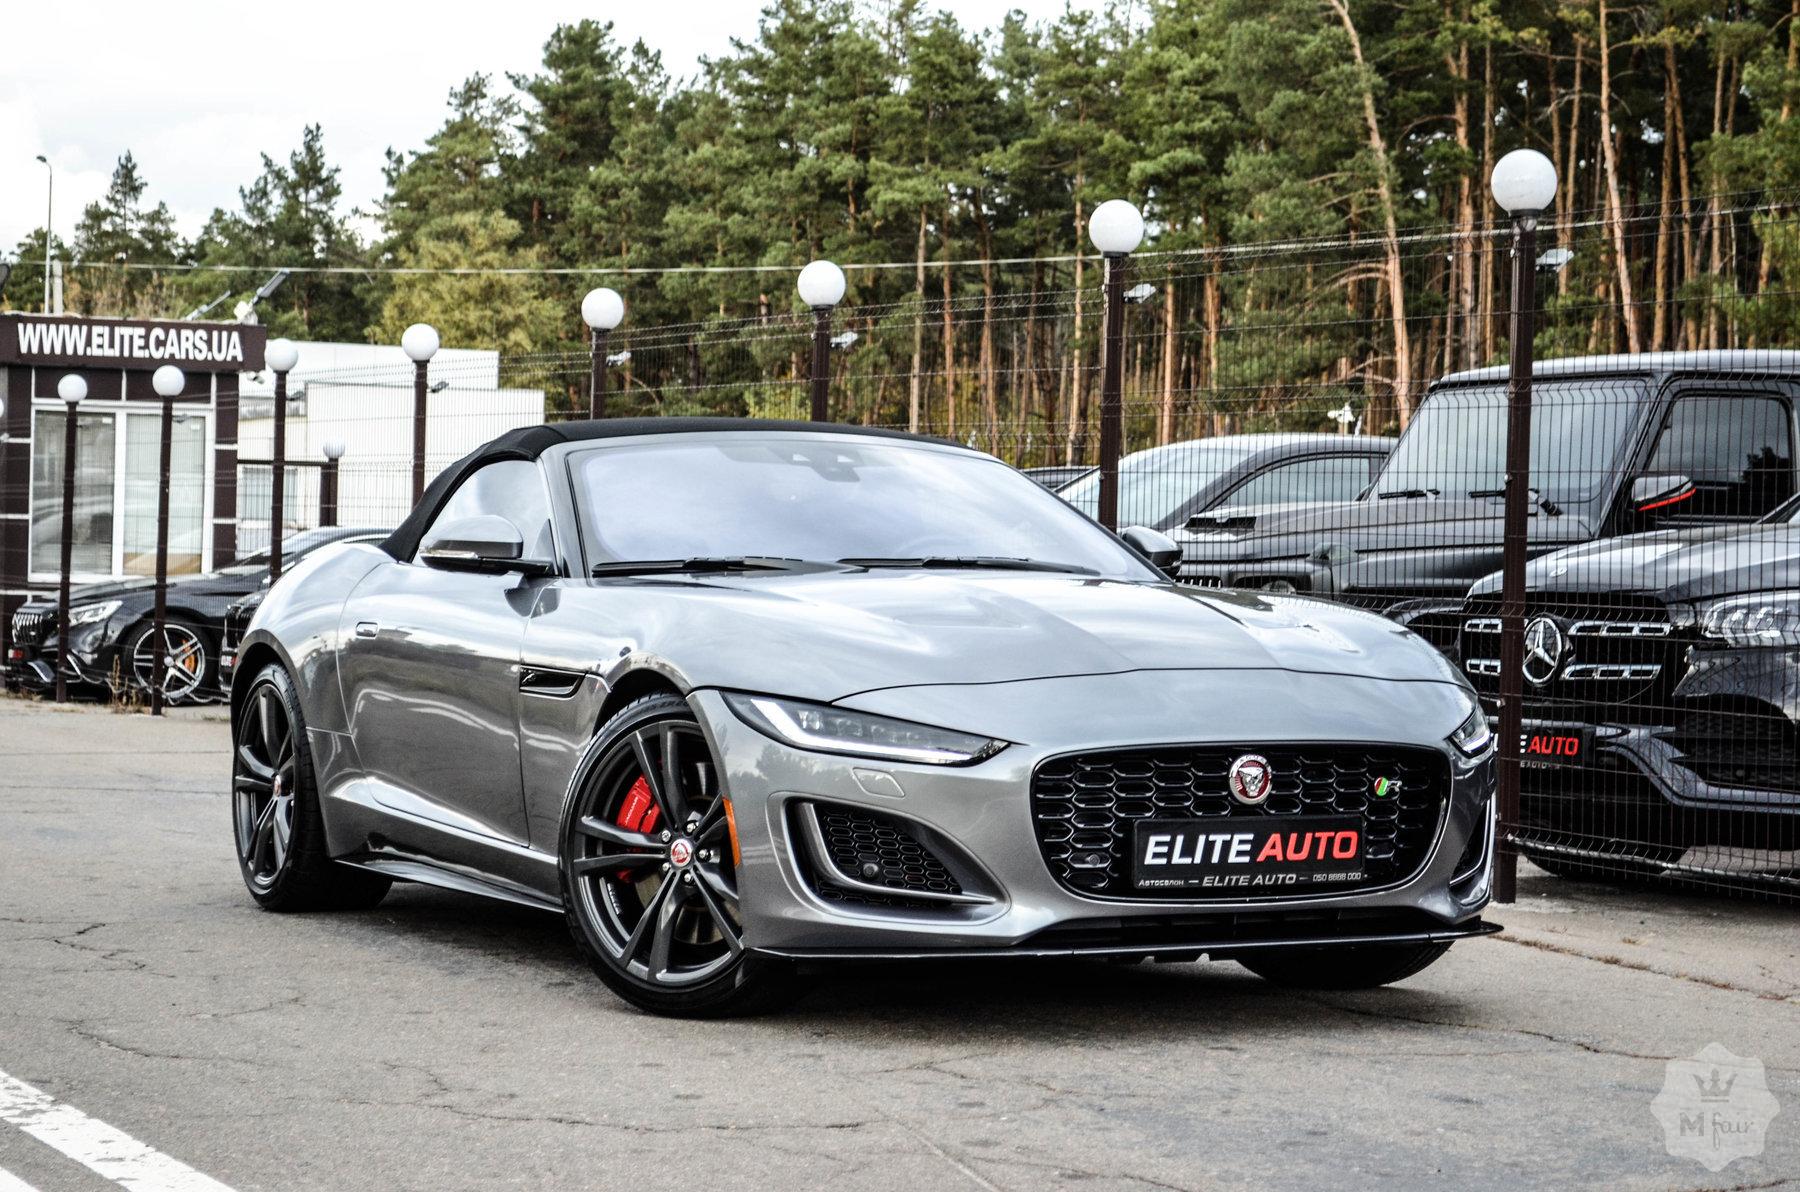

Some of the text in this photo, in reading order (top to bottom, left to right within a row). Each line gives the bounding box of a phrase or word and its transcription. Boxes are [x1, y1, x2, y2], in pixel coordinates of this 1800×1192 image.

[17, 322, 244, 362] WWW.ELITE.CARS.UA
[1526, 735, 1580, 757] AUTO
[1144, 830, 1359, 865] ELITE AUTO
[1202, 875, 1251, 887] ELITE
[1252, 873, 1297, 886] AUTO
